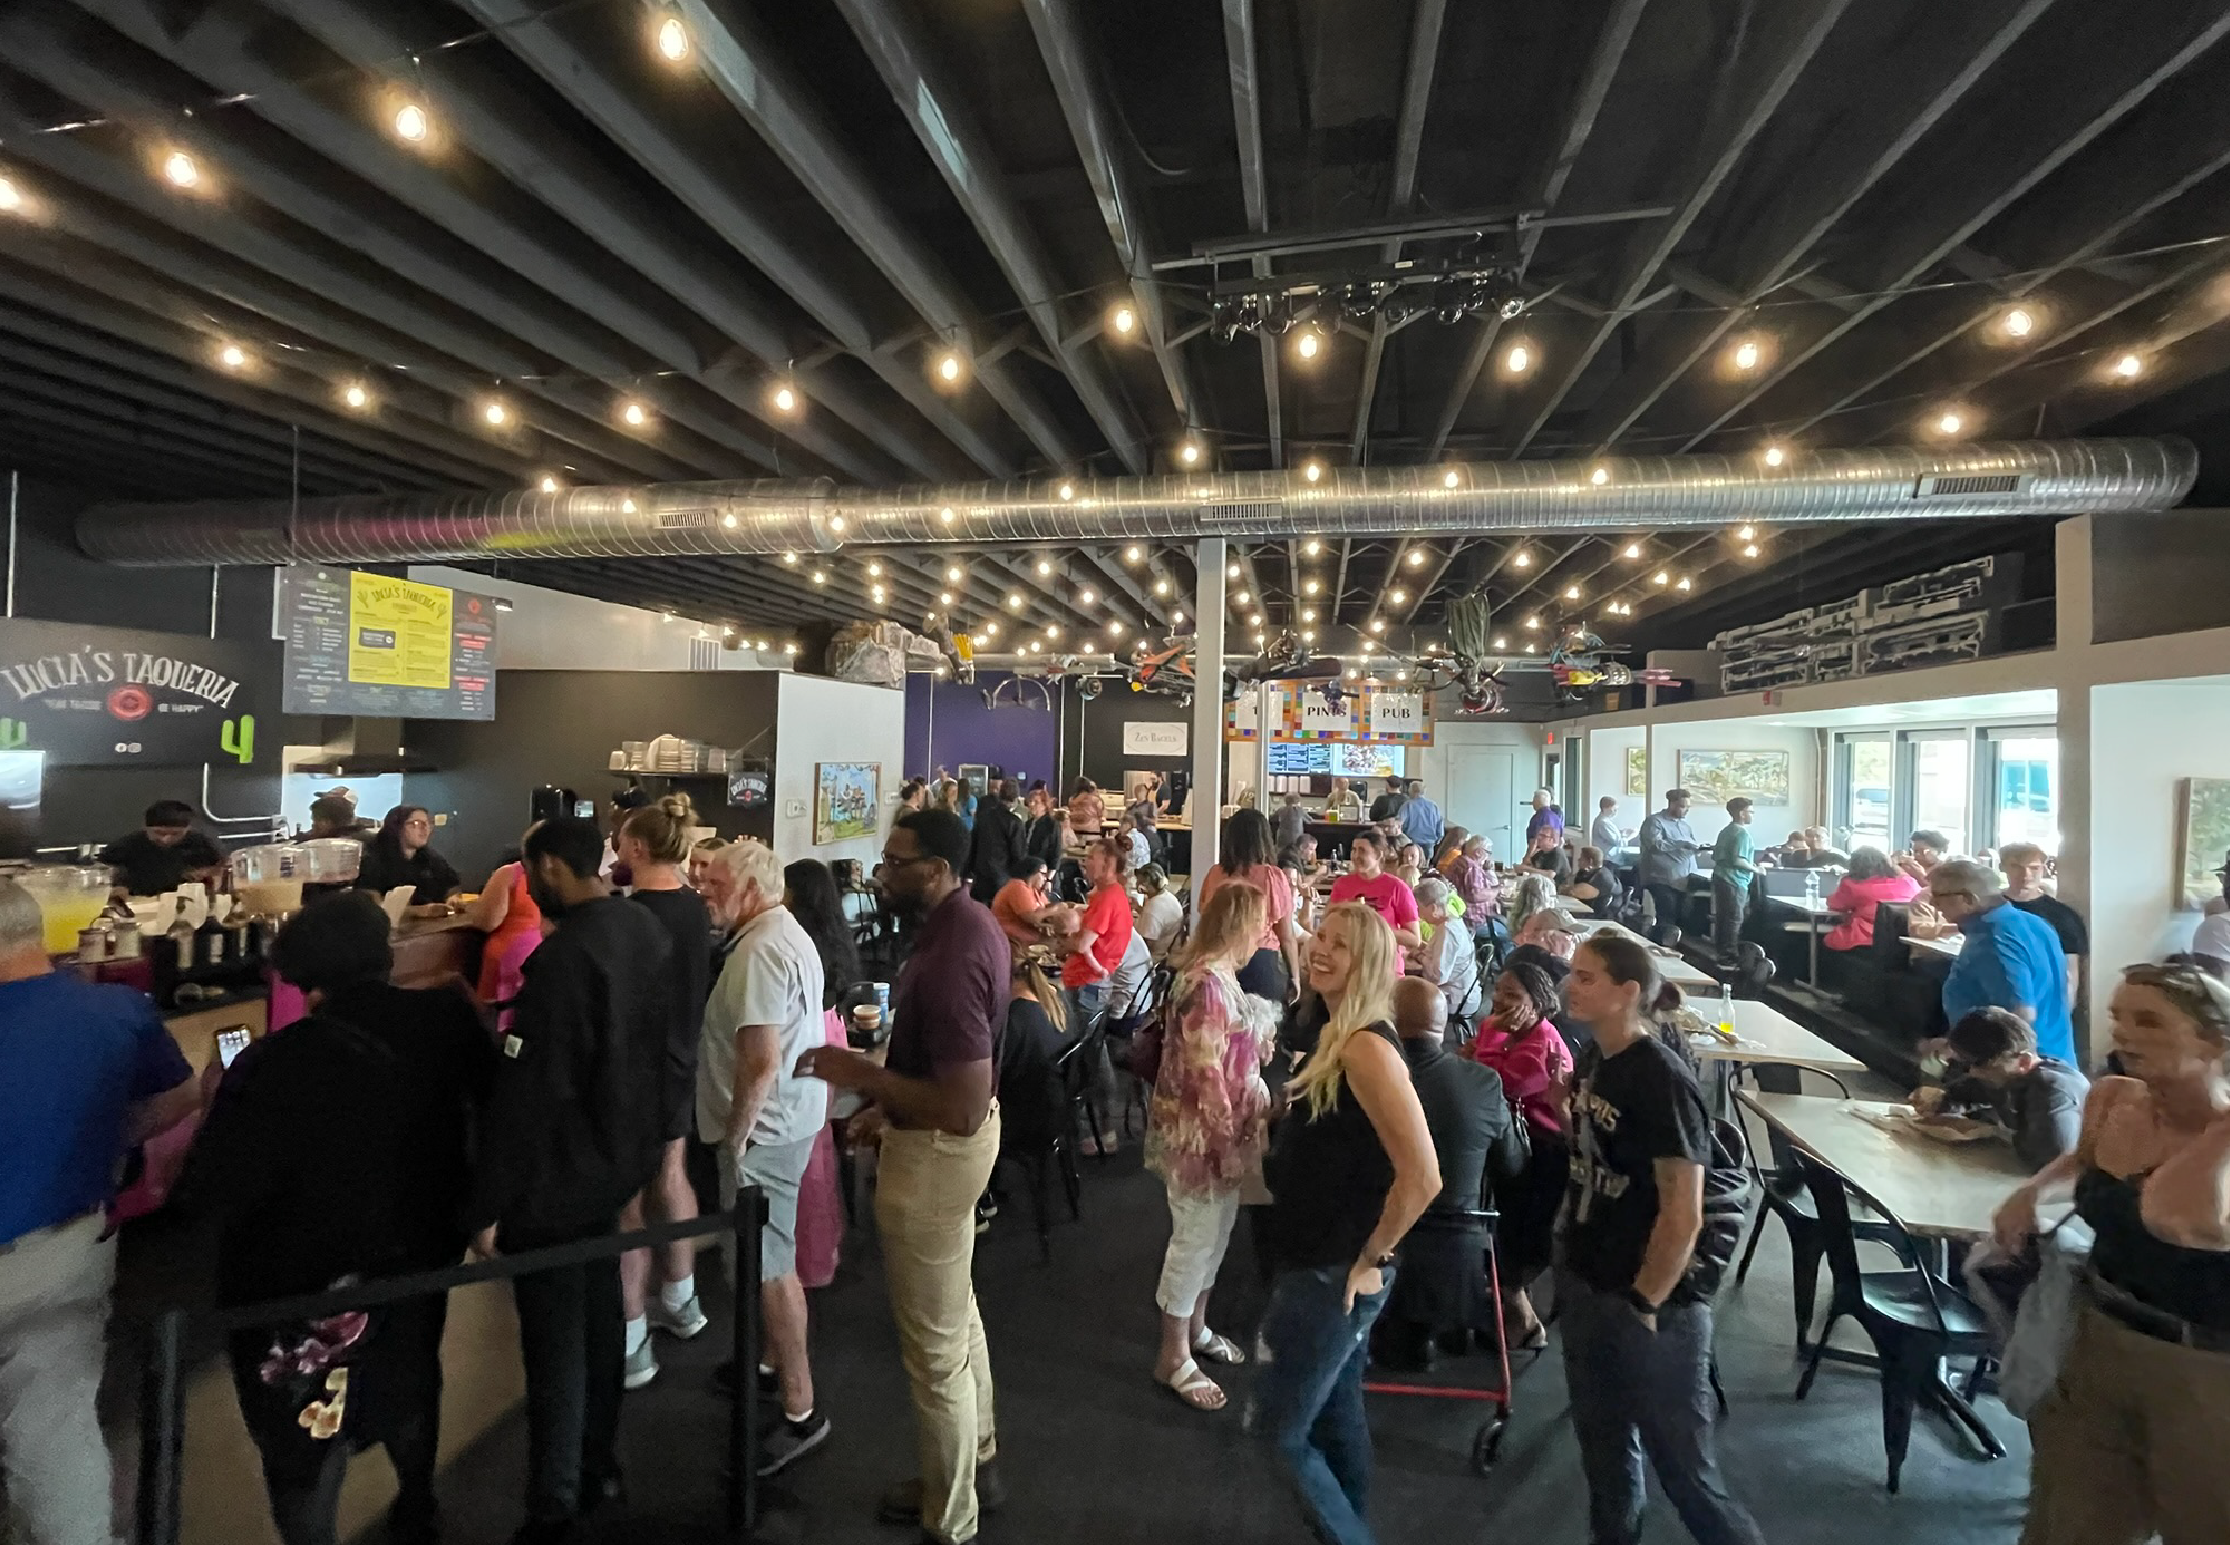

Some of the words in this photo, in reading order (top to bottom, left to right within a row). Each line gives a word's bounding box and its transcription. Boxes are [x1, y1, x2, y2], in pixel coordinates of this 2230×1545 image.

[0, 644, 115, 700] LUCIA'S
[123, 653, 240, 709] TAQUERIA
[1382, 707, 1410, 719] PUB
